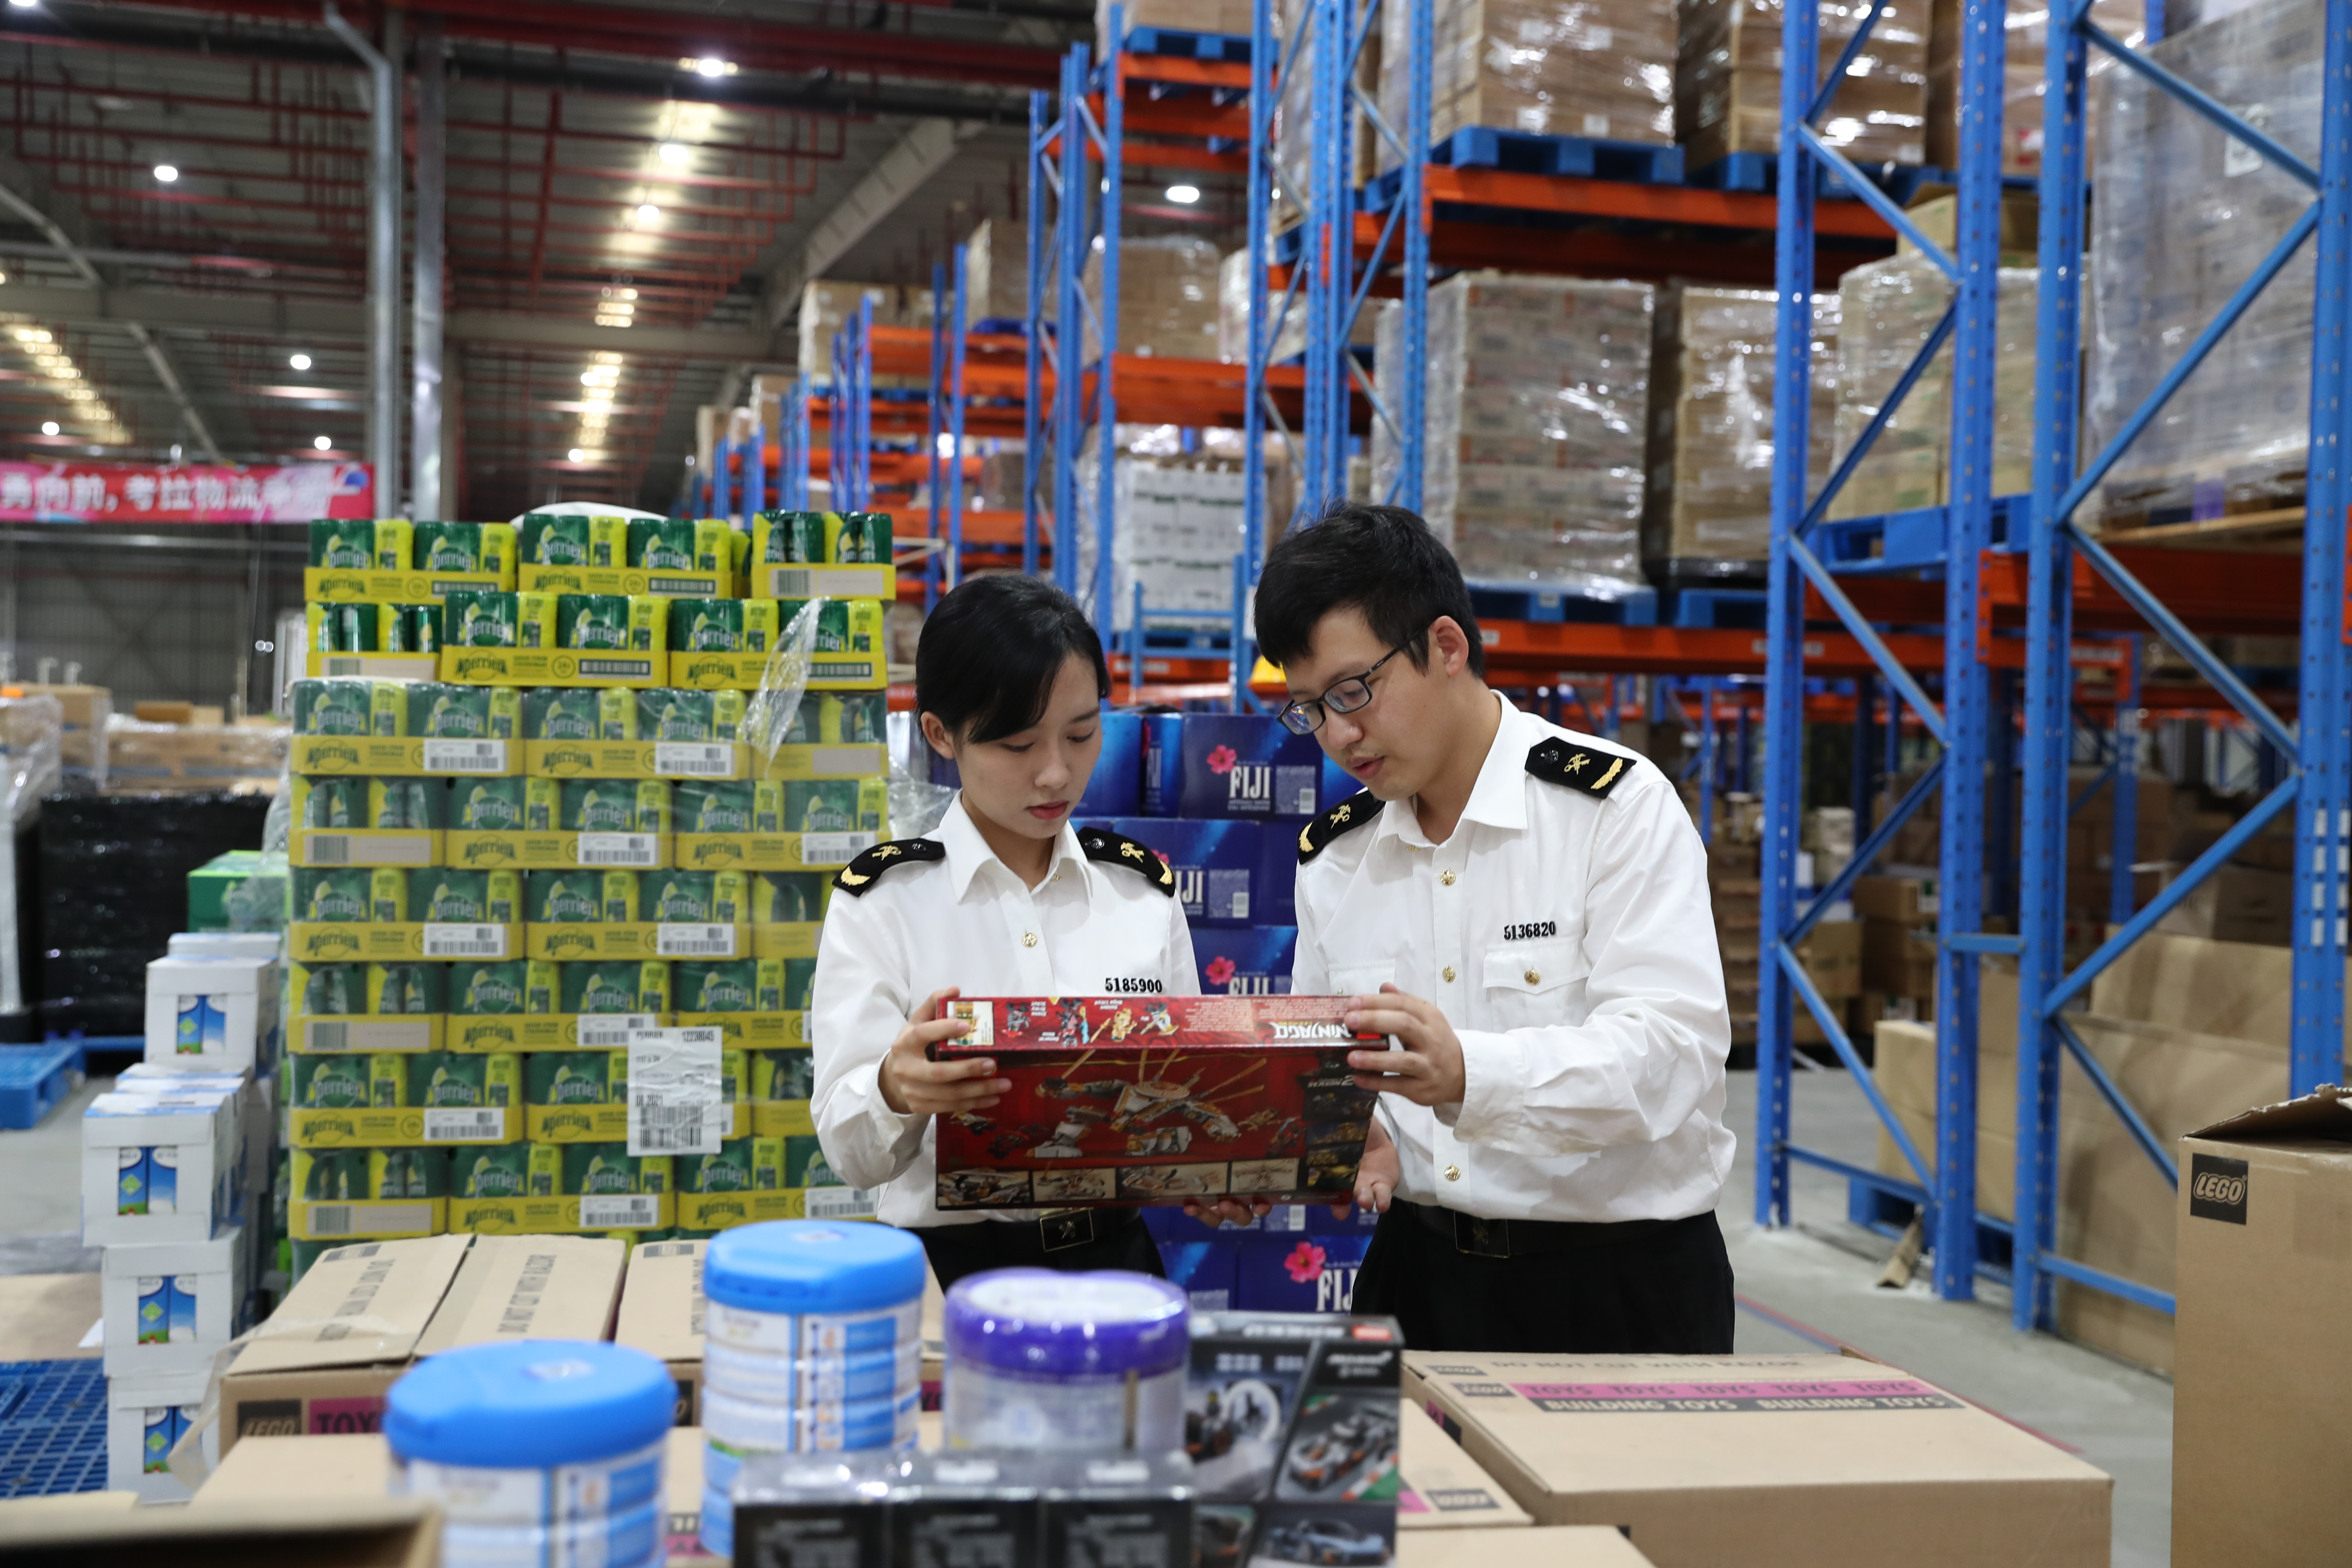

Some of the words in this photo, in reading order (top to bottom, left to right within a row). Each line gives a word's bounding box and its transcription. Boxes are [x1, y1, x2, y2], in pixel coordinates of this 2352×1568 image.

[1229, 766, 1271, 799] FIJI
[1176, 870, 1204, 903] IJI
[1504, 921, 1556, 940] 5136820
[1105, 978, 1162, 993] 5185900
[2193, 1173, 2245, 1205] LEGO
[1316, 1268, 1358, 1312] FIJ
[1526, 1386, 1593, 1395] TOYS
[1608, 1385, 1675, 1394] TOYS
[1690, 1384, 1757, 1394] TOYS
[1770, 1383, 1838, 1393] TOYS
[1850, 1382, 1918, 1392] TOYS
[1543, 1400, 1666, 1411] BUILDING
[1667, 1400, 1738, 1410] TOYS
[1756, 1397, 1876, 1409] BUILDING
[1876, 1396, 1946, 1407] TOYS
